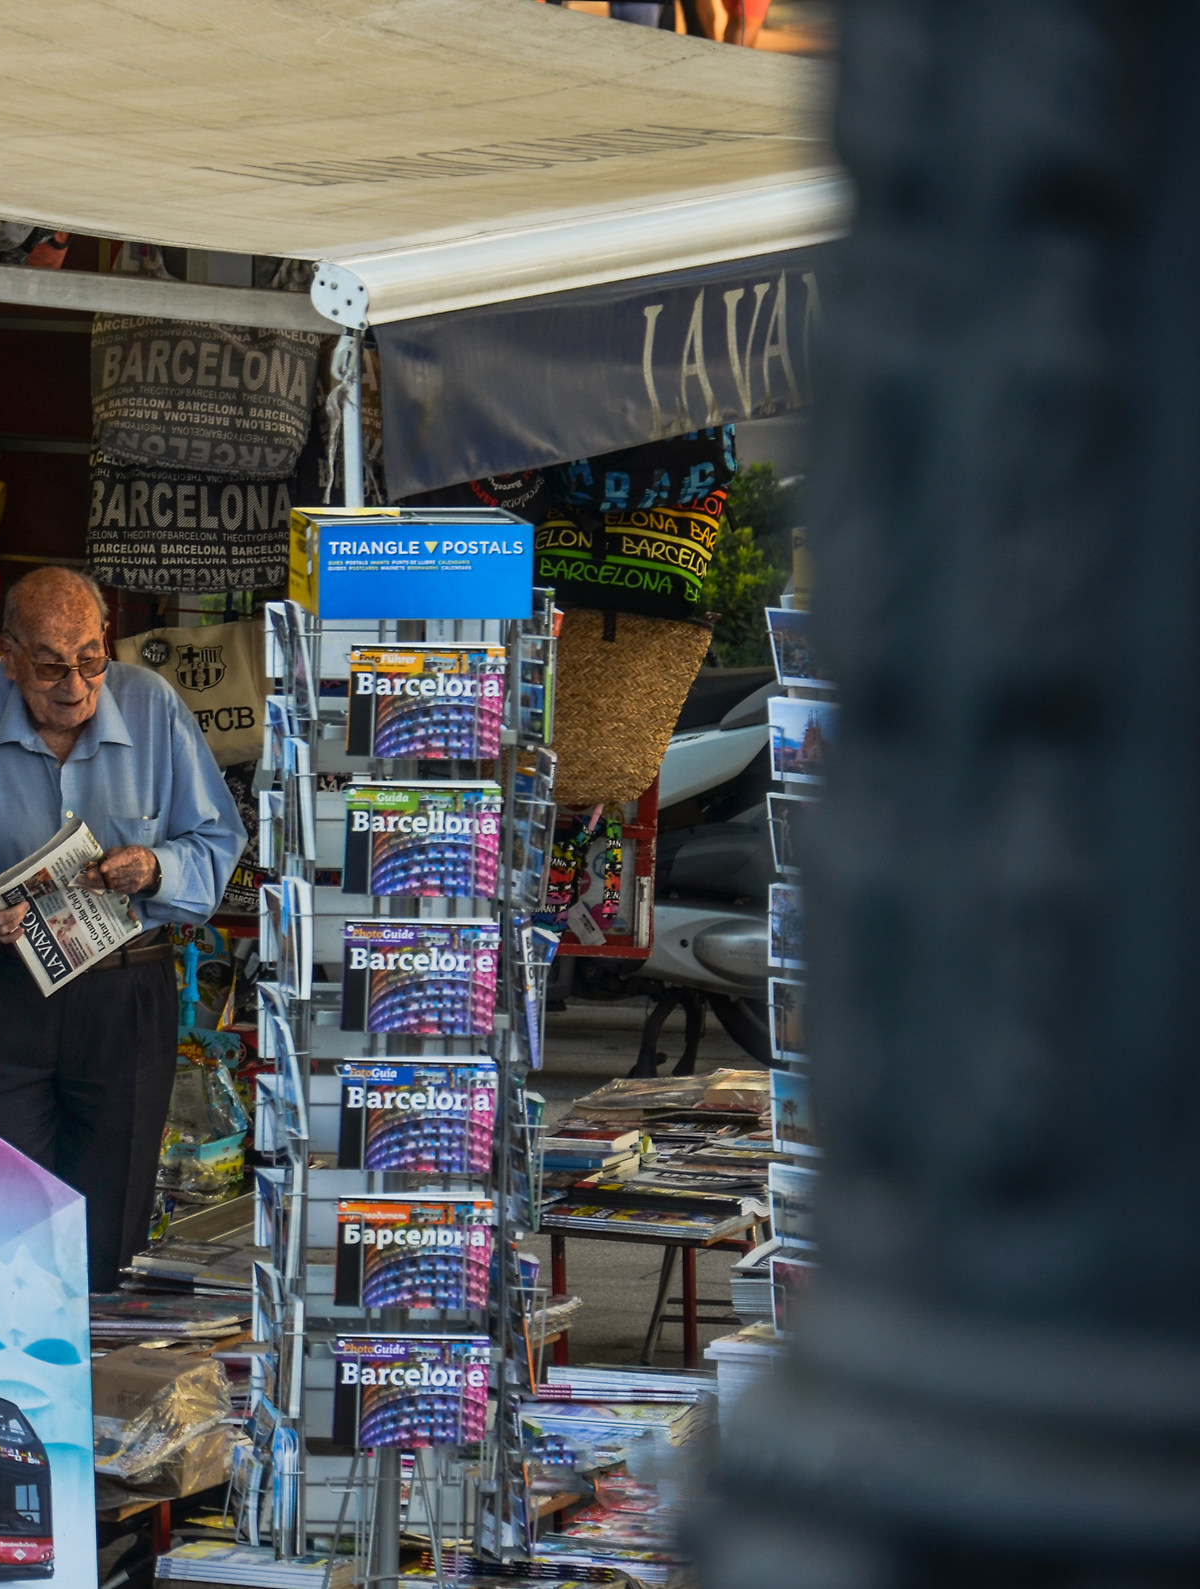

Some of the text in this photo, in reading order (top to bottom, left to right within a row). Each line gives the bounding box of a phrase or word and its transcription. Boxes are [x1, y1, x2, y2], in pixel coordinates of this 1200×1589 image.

[102, 339, 308, 406] BARCELONA
[109, 396, 244, 416] BARCELONA BARCELONA
[88, 480, 291, 531] BARCELONA
[93, 543, 227, 555] BARCELONA BARCELONA
[328, 541, 524, 555] TRIANGLE POSTALS
[540, 556, 673, 595] BARCELONA
[356, 672, 500, 698] Barcelona
[194, 707, 256, 733] FCB
[352, 811, 498, 835] Barcellona
[352, 928, 414, 940] PhotoGuide
[343, 1343, 406, 1356] PhotoGuide
